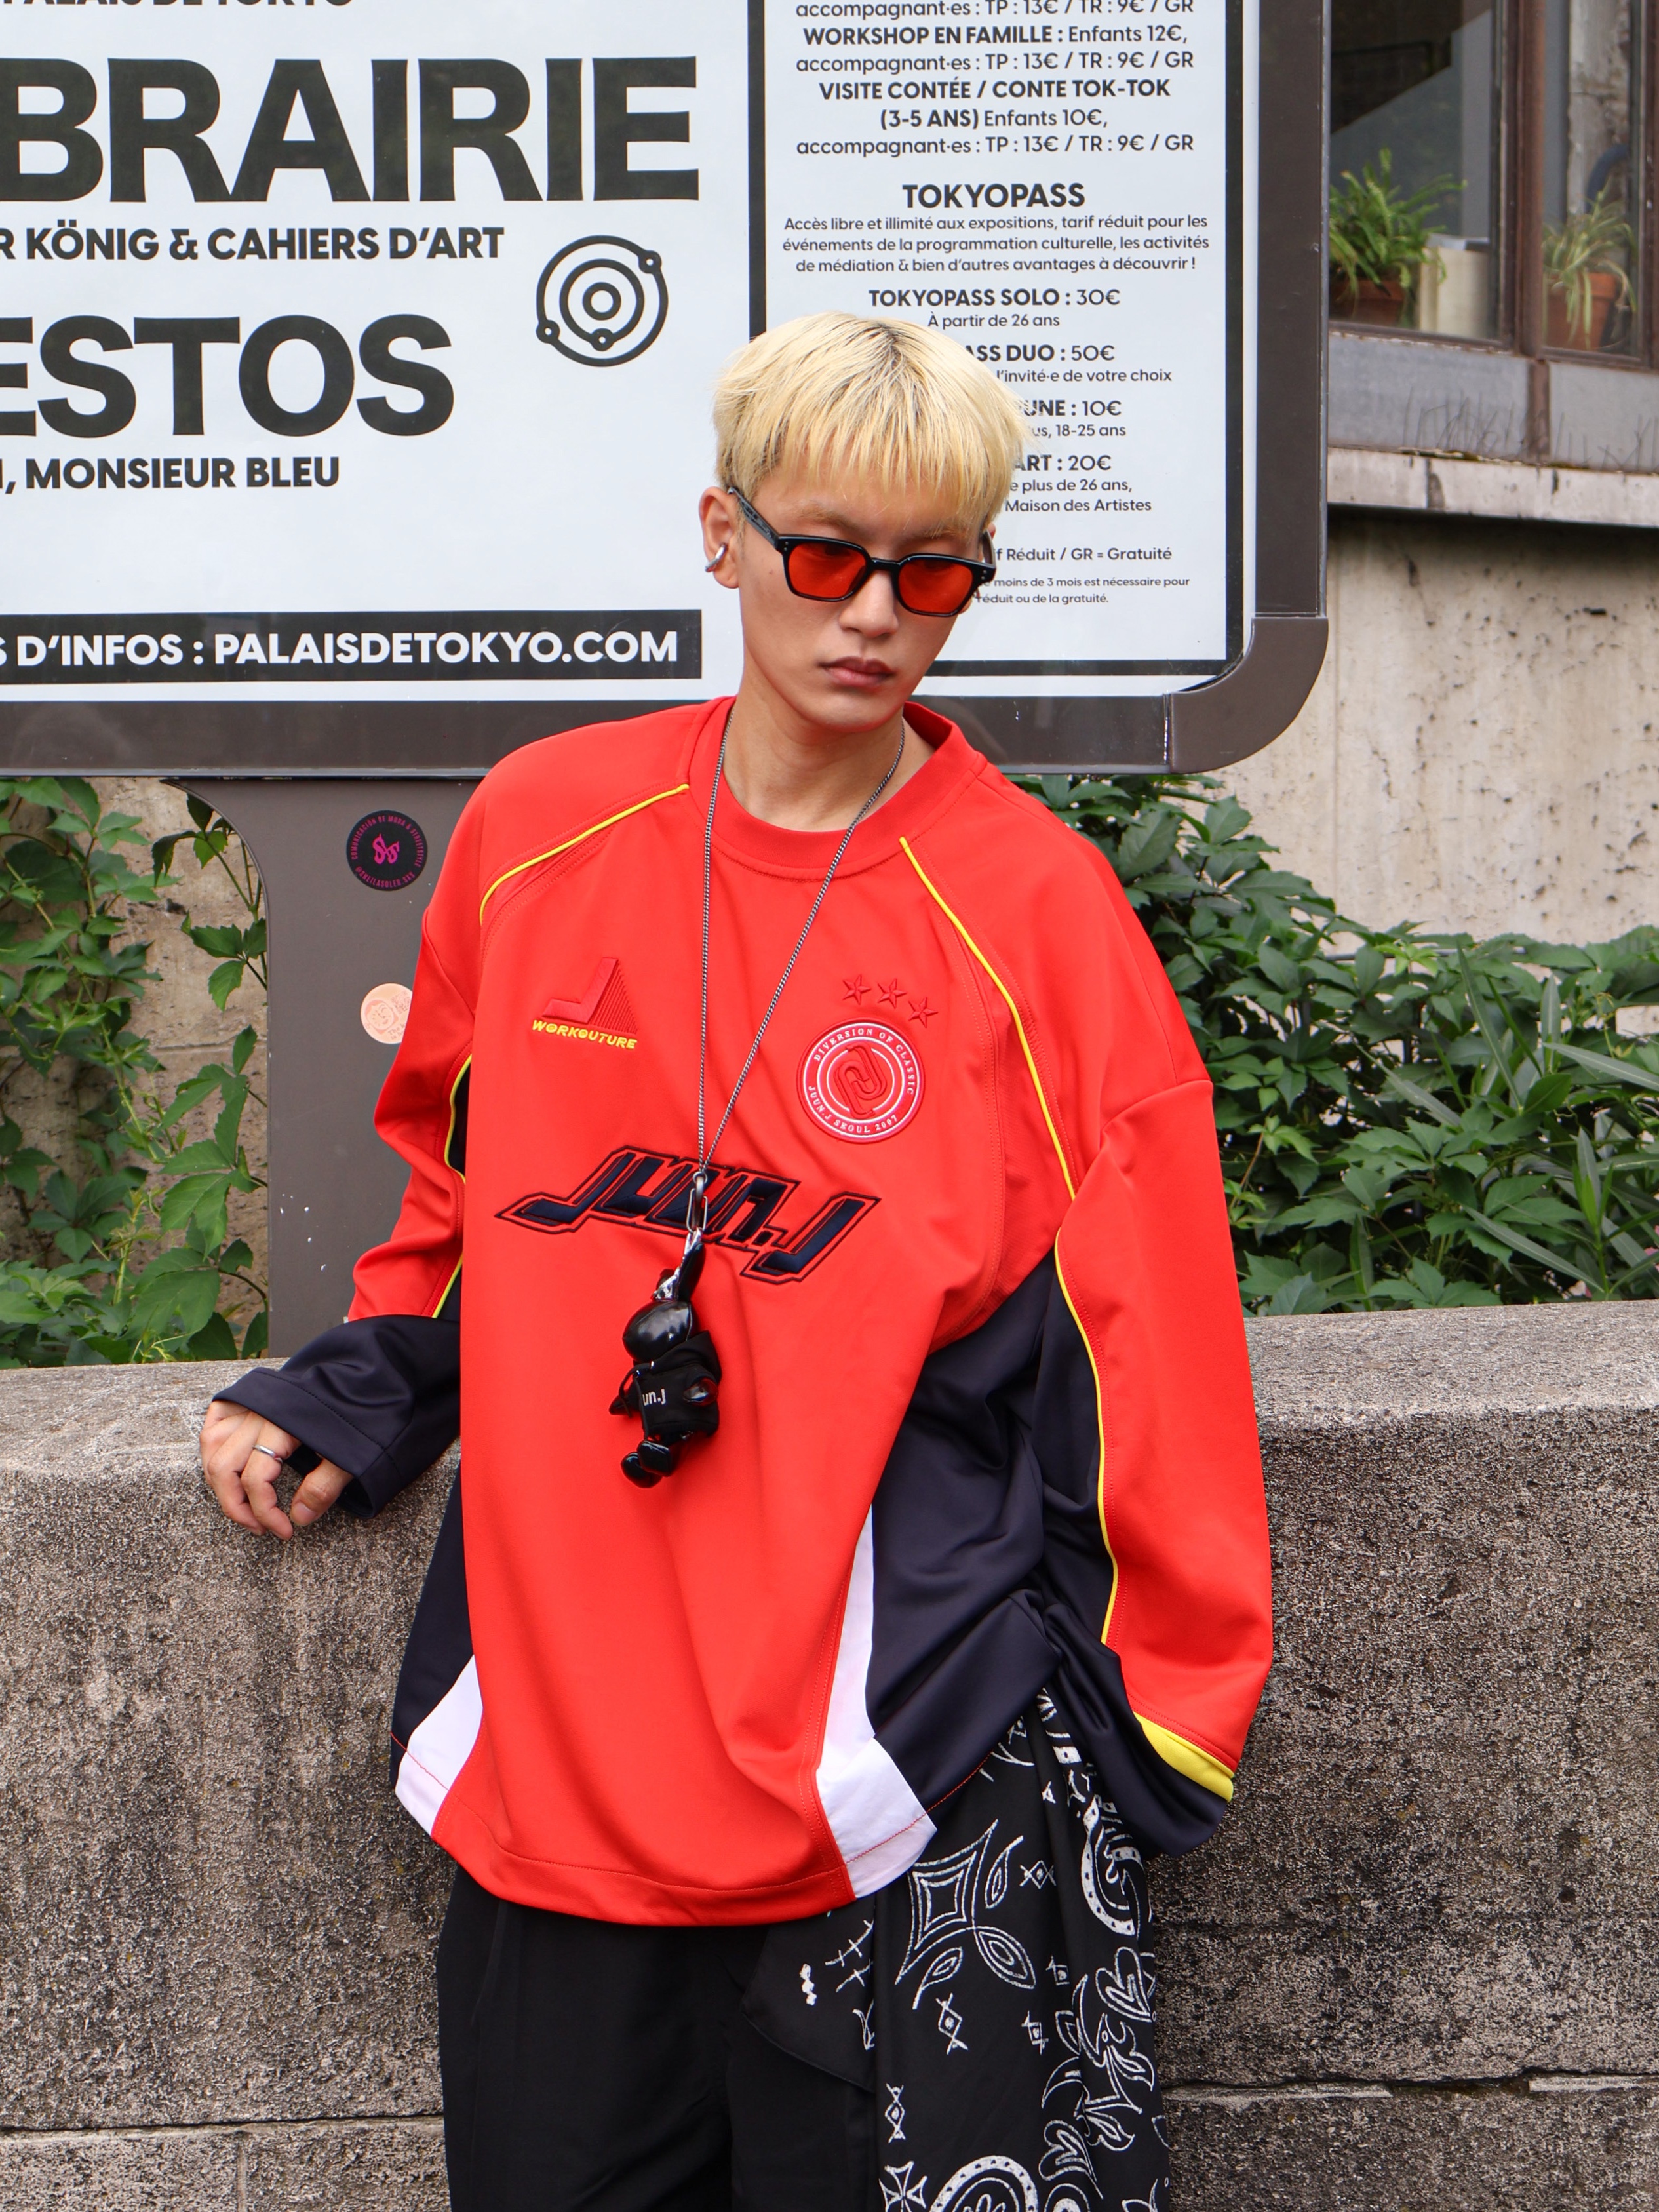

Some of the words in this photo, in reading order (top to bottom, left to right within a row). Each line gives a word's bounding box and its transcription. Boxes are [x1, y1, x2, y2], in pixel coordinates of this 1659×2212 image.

[985, 0, 1007, 14] TP
[1024, 0, 1057, 14] 13€
[1079, 0, 1102, 13] TR
[1118, 0, 1144, 12] 9€
[1165, 0, 1193, 12] GR
[804, 27, 929, 45] WORKSHOP
[935, 27, 960, 43] EN
[967, 26, 1052, 43] FAMILLE
[1069, 26, 1141, 42] Enfants
[1147, 25, 1186, 43] 12€,
[985, 54, 1008, 69] TP
[1024, 53, 1058, 69] 13€
[1079, 52, 1102, 68] TR
[1118, 52, 1144, 68] 9€
[1165, 51, 1193, 68] GR
[819, 83, 882, 100] VISITE
[888, 77, 971, 99] CONTÉE
[992, 80, 1066, 98] CONTE
[1072, 79, 1170, 97] TOK-TOK
[881, 109, 922, 130] (3-5
[927, 109, 978, 129] ANS)
[985, 110, 1057, 126] Enfants
[1063, 109, 1107, 127] 10€,
[985, 136, 1008, 152] TP
[1024, 136, 1058, 152] 13€
[1079, 136, 1102, 151] TR
[1118, 135, 1144, 151] 9€
[1165, 134, 1193, 150] GR
[903, 183, 1085, 208] TOKYOPASS
[785, 218, 827, 229] Accès
[832, 218, 863, 229] libre
[867, 218, 882, 229] et
[886, 217, 933, 229] illimité
[937, 220, 964, 229] aux
[969, 216, 1057, 231] expositions,
[1062, 215, 1094, 228] tarif
[1099, 215, 1143, 227] réduit
[1148, 218, 1184, 230] pour
[1188, 215, 1207, 227] les
[26, 220, 159, 260] KÖNIG
[169, 229, 198, 260] &
[208, 227, 379, 260] CAHIERS
[389, 227, 504, 259] D’ART
[783, 239, 873, 250] événements
[877, 239, 895, 250] de
[900, 239, 912, 250] la
[917, 237, 1037, 253] programmation
[1042, 237, 1116, 250] culturelle,
[1120, 237, 1140, 248] les
[1144, 235, 1209, 248] activités
[796, 260, 815, 271] de
[819, 260, 894, 271] médiation
[899, 259, 908, 271] &
[913, 259, 944, 271] bien
[948, 259, 1009, 271] d’autres
[1013, 259, 1095, 273] avantages
[1099, 257, 1108, 269] à
[1113, 257, 1188, 269] découvrir
[869, 289, 995, 306] TOKYOPASS
[1001, 288, 1059, 306] SOLO
[1077, 289, 1120, 305] 30€
[928, 311, 939, 326] À
[943, 315, 985, 330] partir
[988, 315, 1007, 326] de
[1012, 314, 1028, 326] 26
[1033, 317, 1059, 326] ans
[1006, 344, 1054, 361] DUO
[1072, 345, 1114, 361] 50€
[1063, 370, 1082, 382] de
[1087, 370, 1127, 381] votre
[1131, 369, 1171, 381] choix
[1020, 400, 1065, 416] UNE
[1082, 401, 1121, 416] 10€
[1056, 424, 1095, 436] 18-25
[1099, 427, 1125, 436] ans
[1068, 455, 1111, 470] 20€
[26, 458, 236, 489] MONSIEUR
[247, 457, 339, 487] BLEU
[1023, 479, 1053, 494] plus
[1057, 479, 1076, 491] de
[1080, 479, 1097, 490] 26
[1101, 482, 1131, 492] ans,
[1005, 500, 1059, 511] Maison
[1064, 500, 1089, 511] des
[1094, 499, 1151, 511] Artistes
[1007, 549, 1055, 560] Réduit
[1071, 548, 1092, 560] GR
[1108, 547, 1171, 560] Gratuité
[994, 578, 1028, 586] moins
[1047, 578, 1053, 586] 3
[1057, 578, 1082, 586] mois
[1103, 577, 1161, 586] nécessaire
[1164, 579, 1190, 587] pour
[1062, 594, 1108, 604] gratuité.
[18, 634, 183, 665] D’INFOS
[215, 631, 676, 663] PALAISDETOKYO.COM
[532, 1019, 637, 1050] WORKOUTURE
[814, 1028, 873, 1061] DIVERSION
[879, 1031, 893, 1044] OF
[896, 1044, 915, 1095] CLASSIC
[808, 1086, 831, 1120] JUUN.J
[833, 1119, 871, 1134] SEOUL
[874, 1114, 898, 1132] 2007
[642, 1389, 666, 1406] un.J
